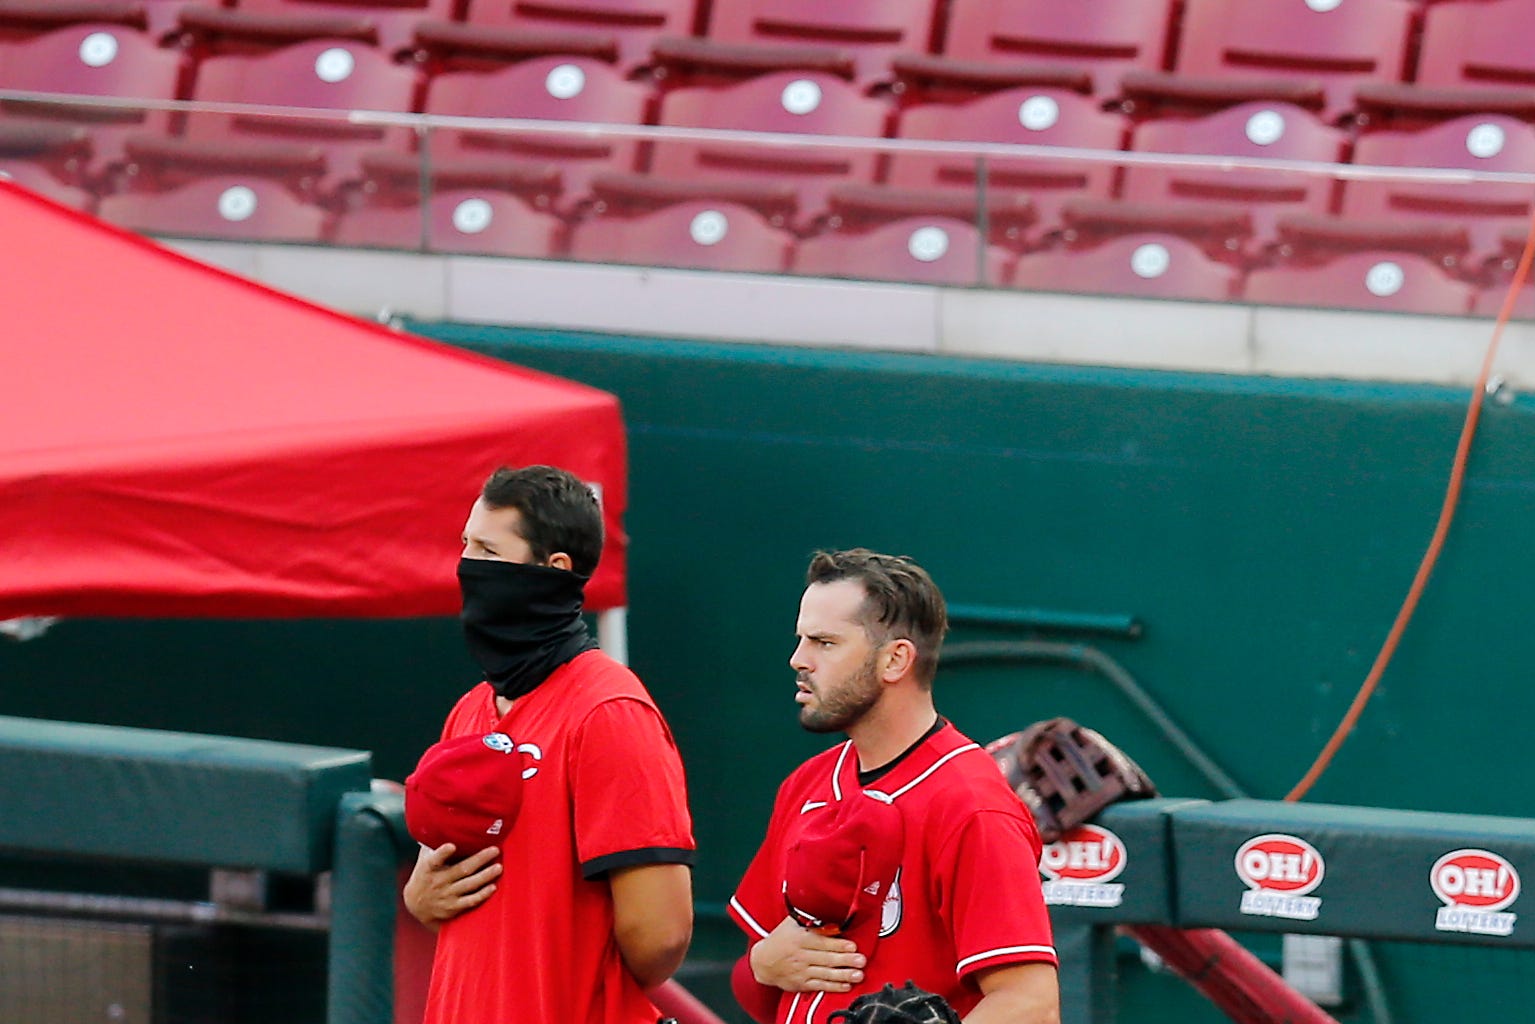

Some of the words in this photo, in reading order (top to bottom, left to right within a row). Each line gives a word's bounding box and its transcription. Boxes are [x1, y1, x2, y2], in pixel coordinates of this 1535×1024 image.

[1042, 838, 1114, 870] OH!
[1243, 849, 1313, 882] OH!
[1438, 864, 1509, 898] OH!
